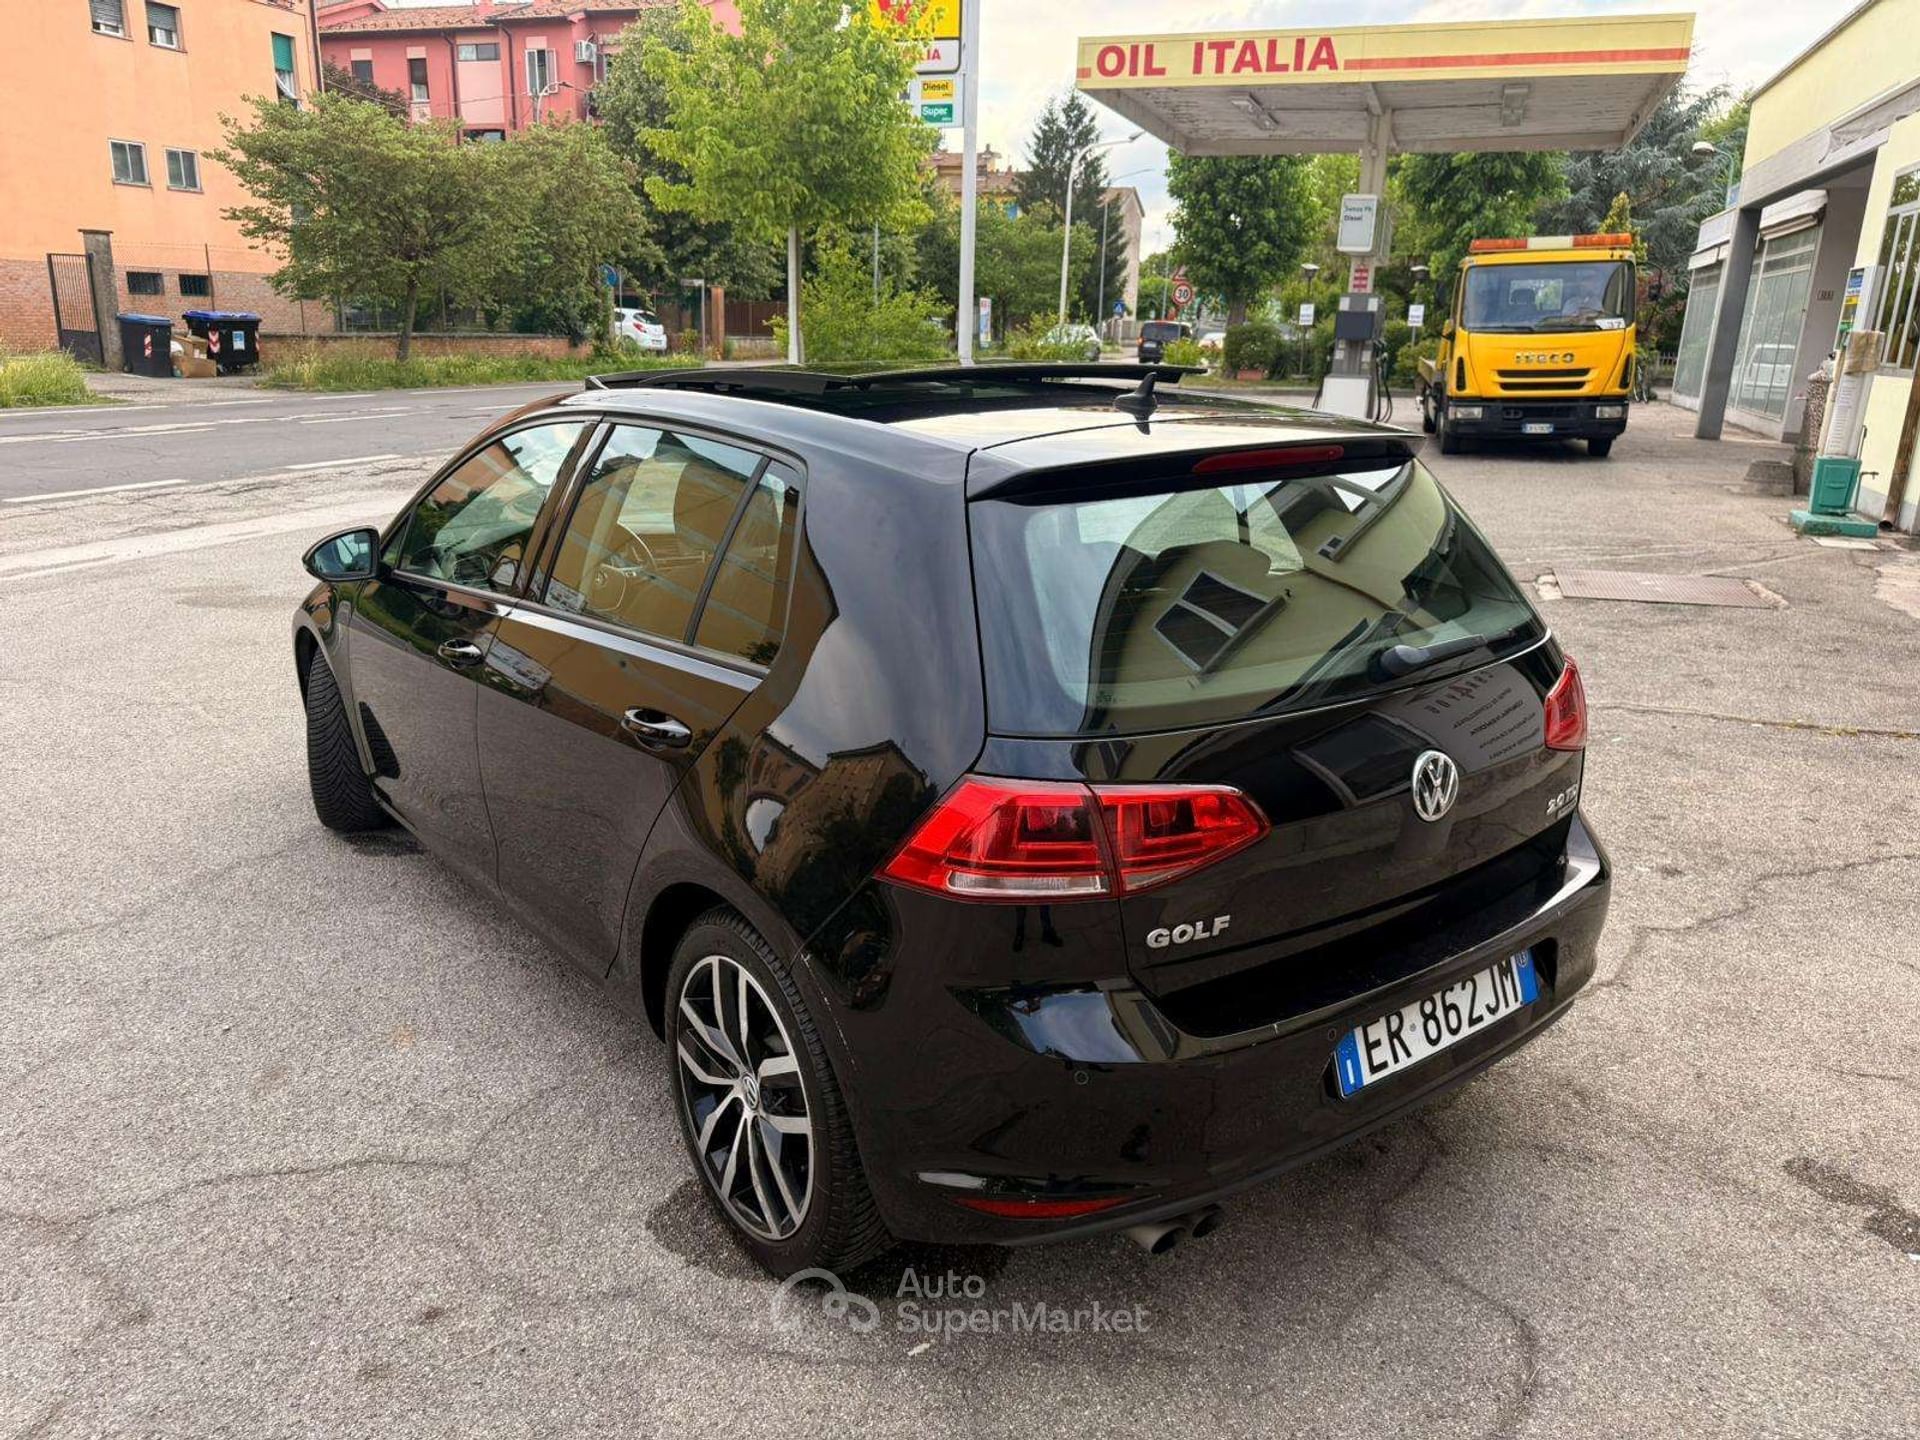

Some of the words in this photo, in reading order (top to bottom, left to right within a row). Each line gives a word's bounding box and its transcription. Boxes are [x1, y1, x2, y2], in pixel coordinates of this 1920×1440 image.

[1096, 44, 1166, 77] OIL
[1192, 37, 1338, 75] ITALIA
[922, 82, 949, 92] Diesel
[922, 106, 949, 117] Super
[1178, 288, 1189, 299] 30
[1146, 914, 1231, 949] GOLF
[1362, 1008, 1412, 1075] ER
[1419, 960, 1520, 1047] 862JM
[1346, 1059, 1355, 1085] I
